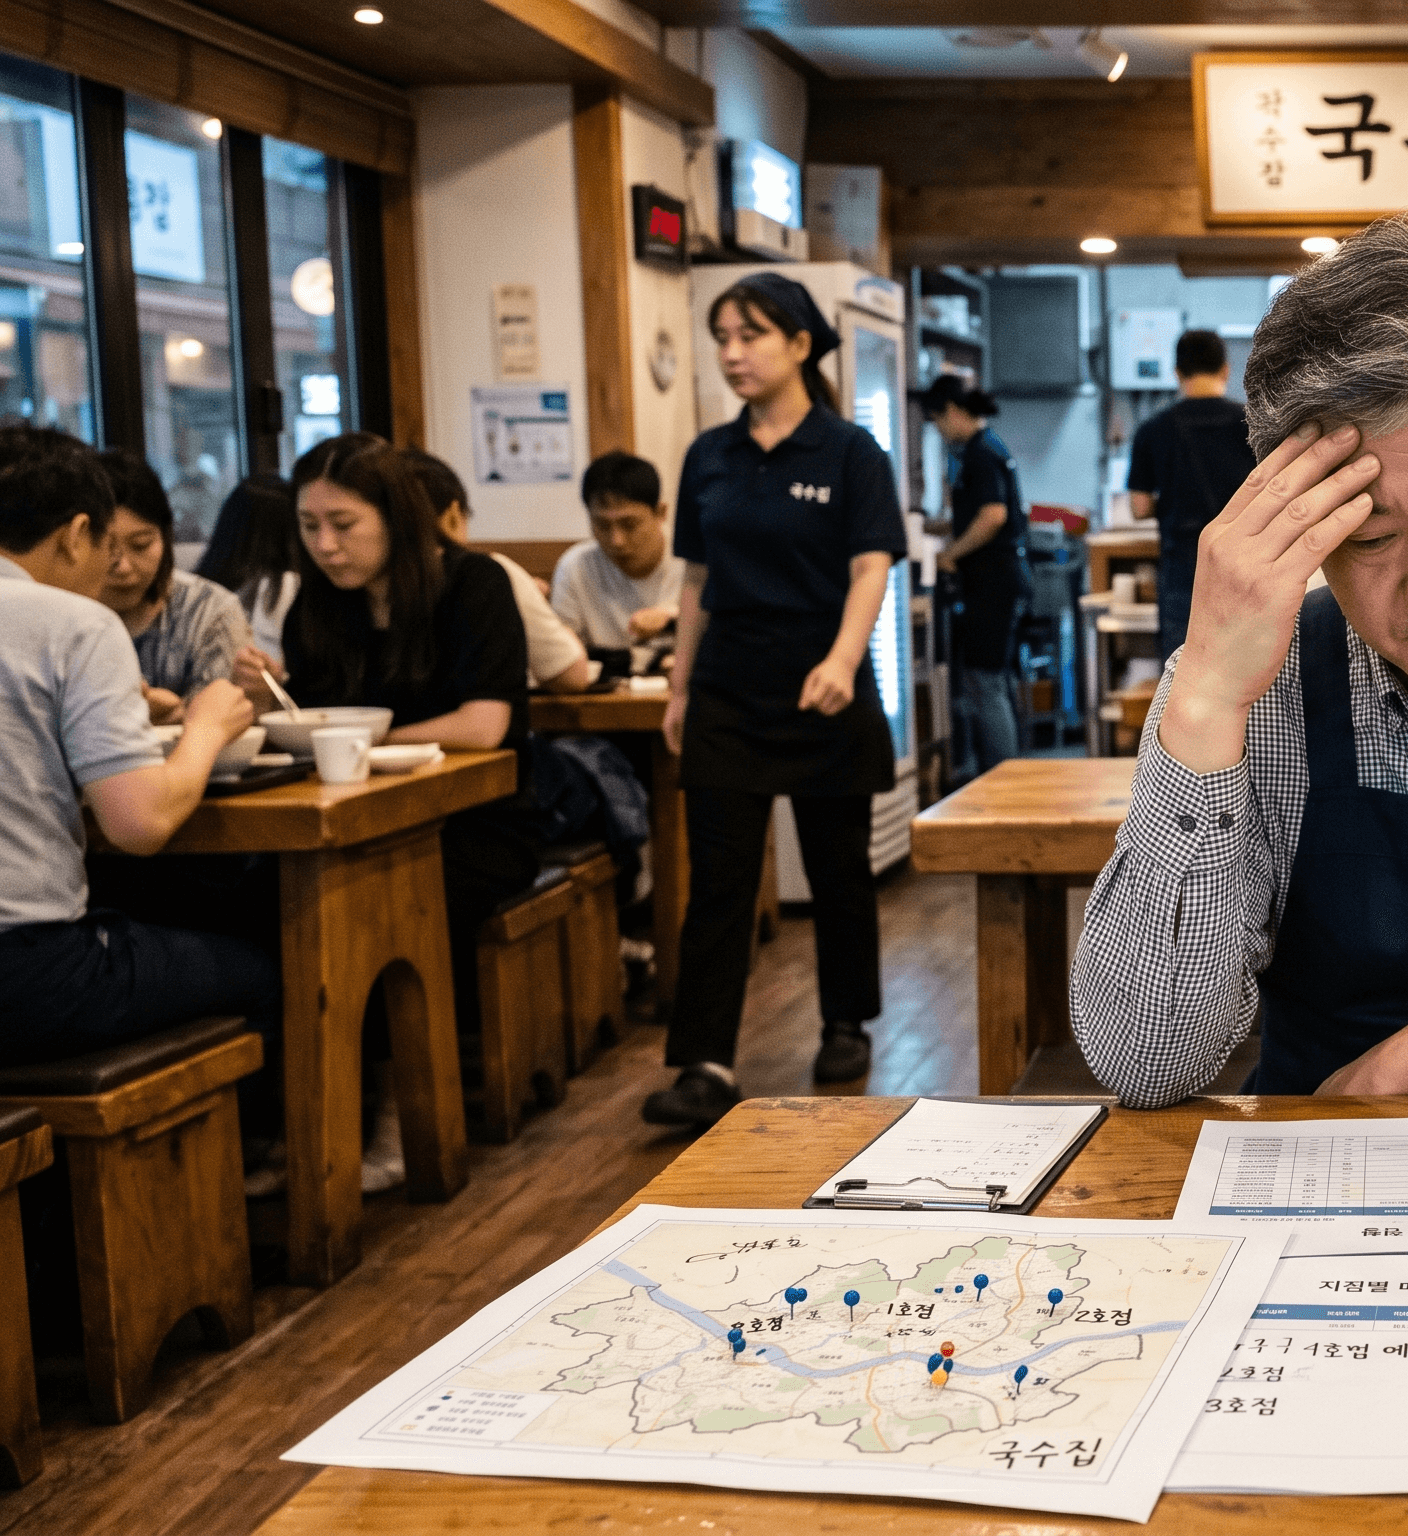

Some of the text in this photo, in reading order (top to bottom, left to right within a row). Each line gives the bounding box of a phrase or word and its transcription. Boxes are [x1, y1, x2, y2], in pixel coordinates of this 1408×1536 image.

[1075, 1308, 1132, 1326] 2호점
[1205, 1397, 1277, 1416] 3호점
[989, 1437, 1102, 1469] 국수집
